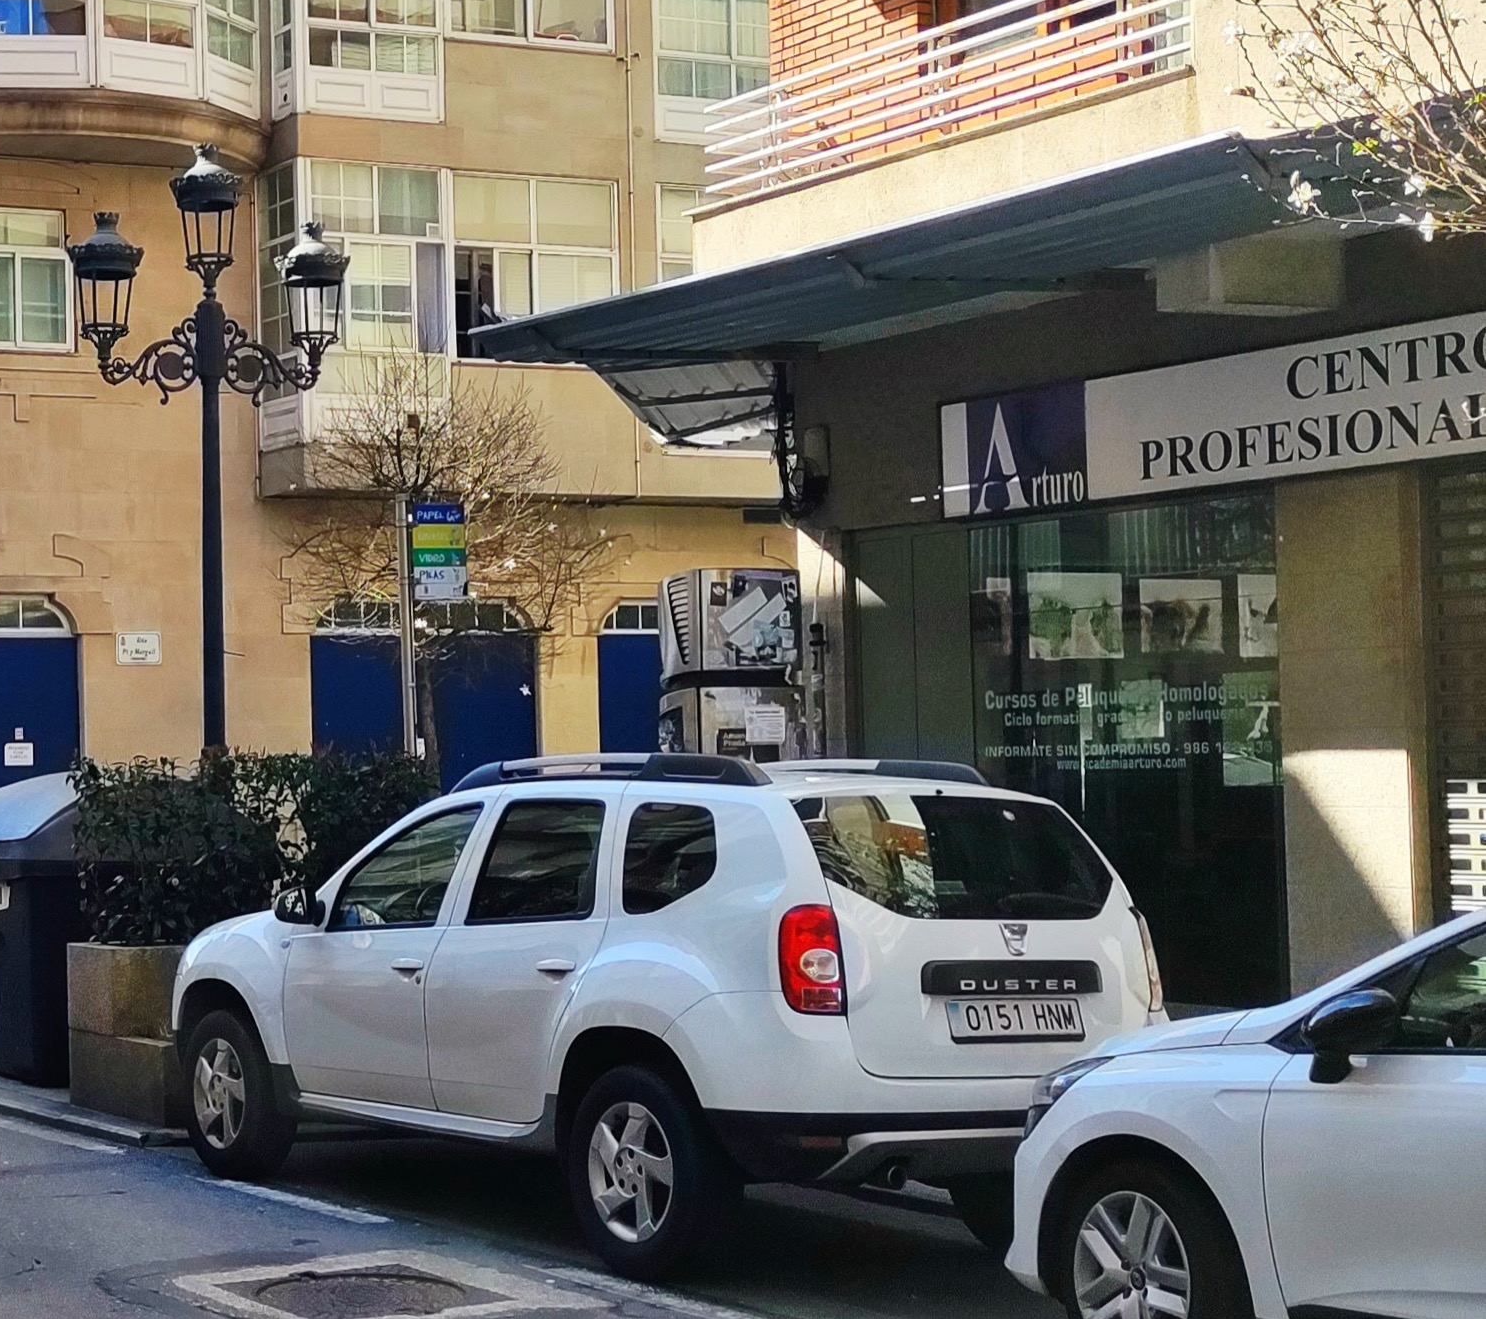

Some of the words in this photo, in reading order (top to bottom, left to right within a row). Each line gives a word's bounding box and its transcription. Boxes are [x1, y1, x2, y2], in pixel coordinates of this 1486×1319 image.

[974, 402, 1084, 515] Arturo
[416, 510, 444, 520] PAPEL
[419, 570, 445, 580] PILAS
[985, 689, 1037, 710] Cursos
[1042, 688, 1059, 707] de
[1004, 712, 1032, 726] Ciclo
[1036, 711, 1089, 726] formati
[1097, 711, 1130, 728] grad
[985, 745, 1053, 758] INFORMATE
[1056, 744, 1078, 757] SIN
[1084, 742, 1170, 757] COMPROMISO
[1183, 741, 1210, 755] 986
[960, 979, 1077, 991] DUSTER
[965, 1004, 1024, 1031] 0151
[1033, 1004, 1077, 1030] HNM
